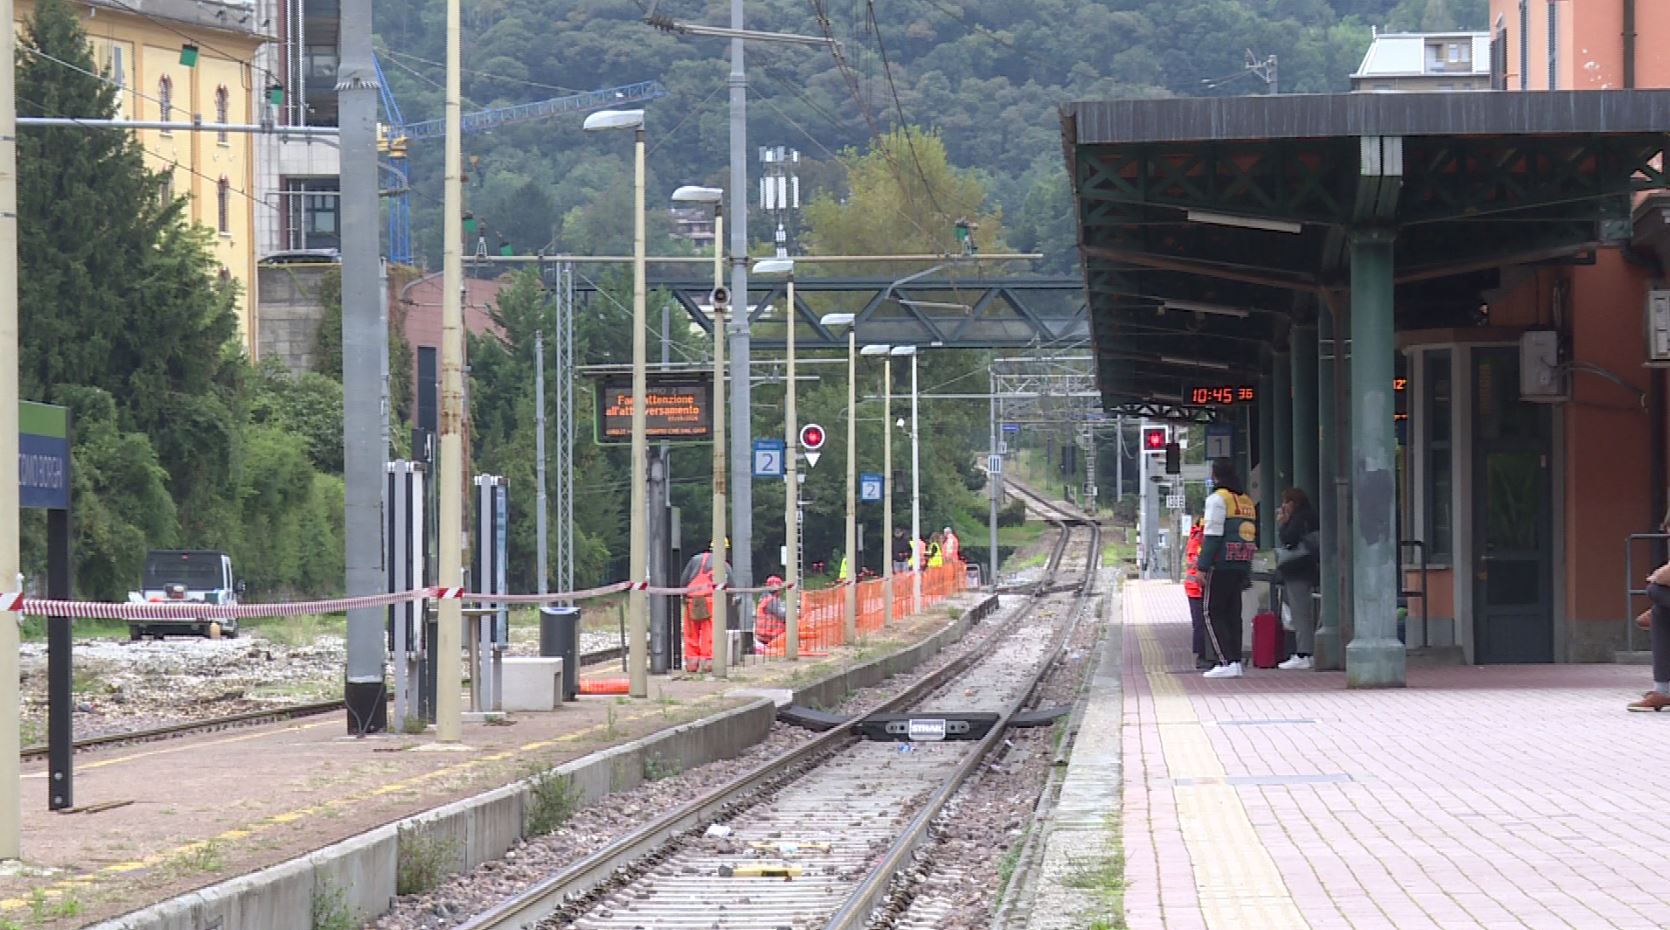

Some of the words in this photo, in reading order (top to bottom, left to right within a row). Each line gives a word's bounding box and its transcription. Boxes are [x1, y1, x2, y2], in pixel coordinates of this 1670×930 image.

[1193, 388, 1233, 404] 10:45
[1238, 388, 1253, 400] 36
[762, 453, 774, 471] 2
[867, 483, 876, 497] 2
